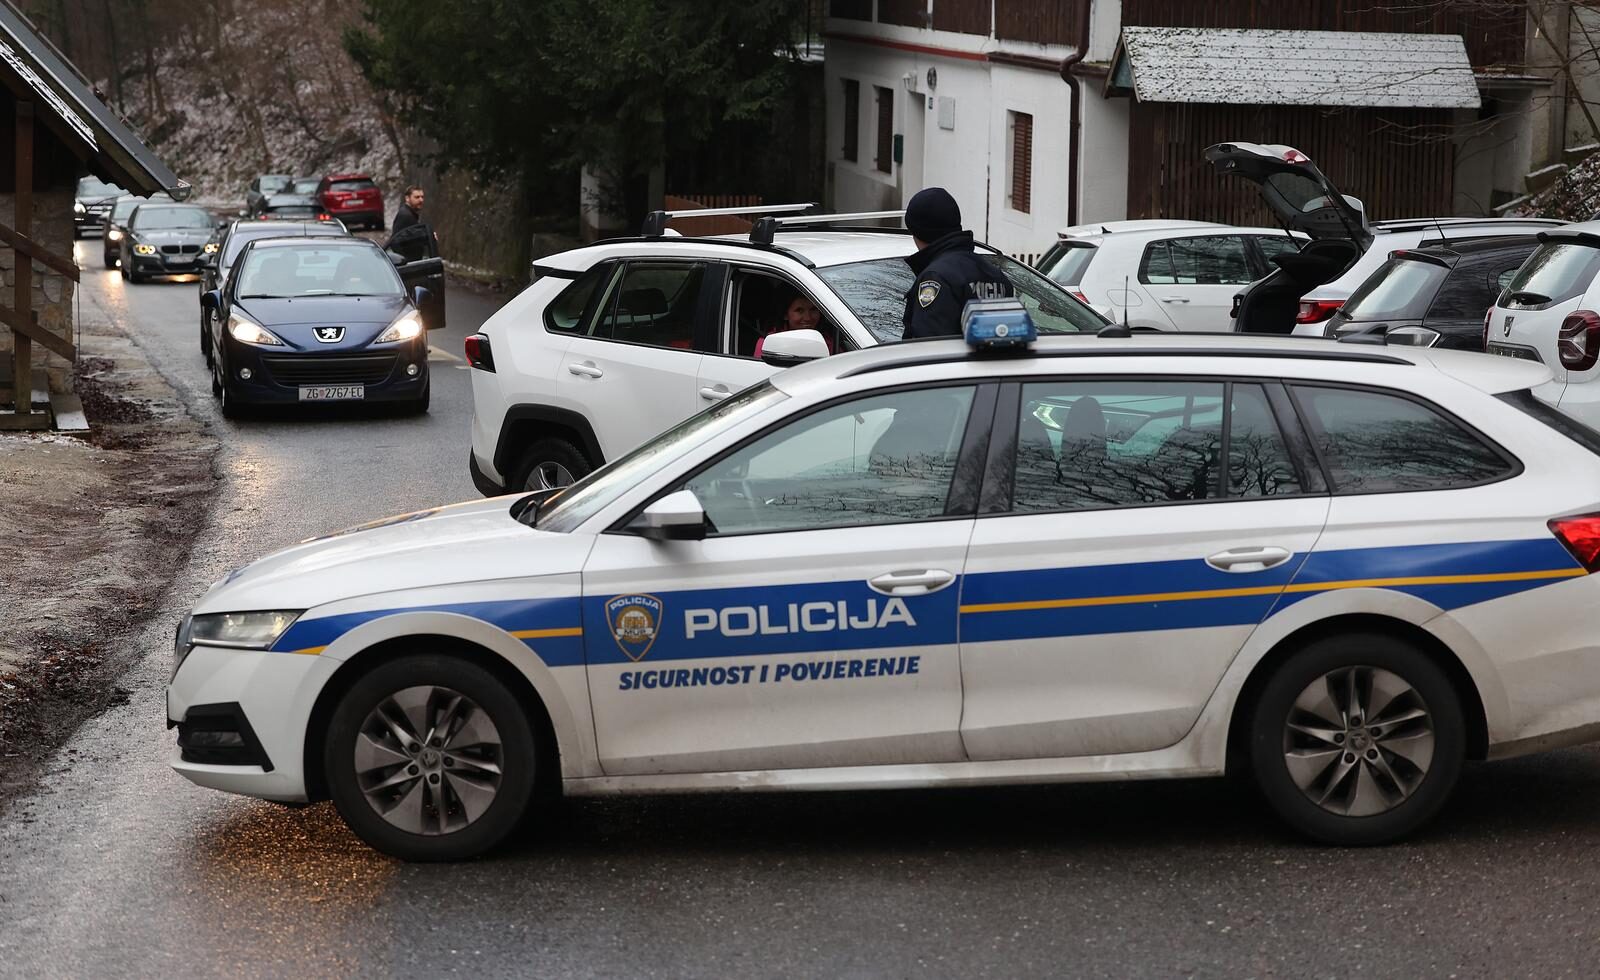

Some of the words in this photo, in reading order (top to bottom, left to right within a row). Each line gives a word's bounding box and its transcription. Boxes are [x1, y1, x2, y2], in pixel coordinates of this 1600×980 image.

[306, 388, 319, 399] ZG
[610, 596, 659, 610] POLICIJA
[684, 597, 917, 639] POLICIJA
[619, 666, 756, 690] SIGURNOST
[759, 664, 769, 683] I
[774, 656, 921, 682] POVJERENJE
